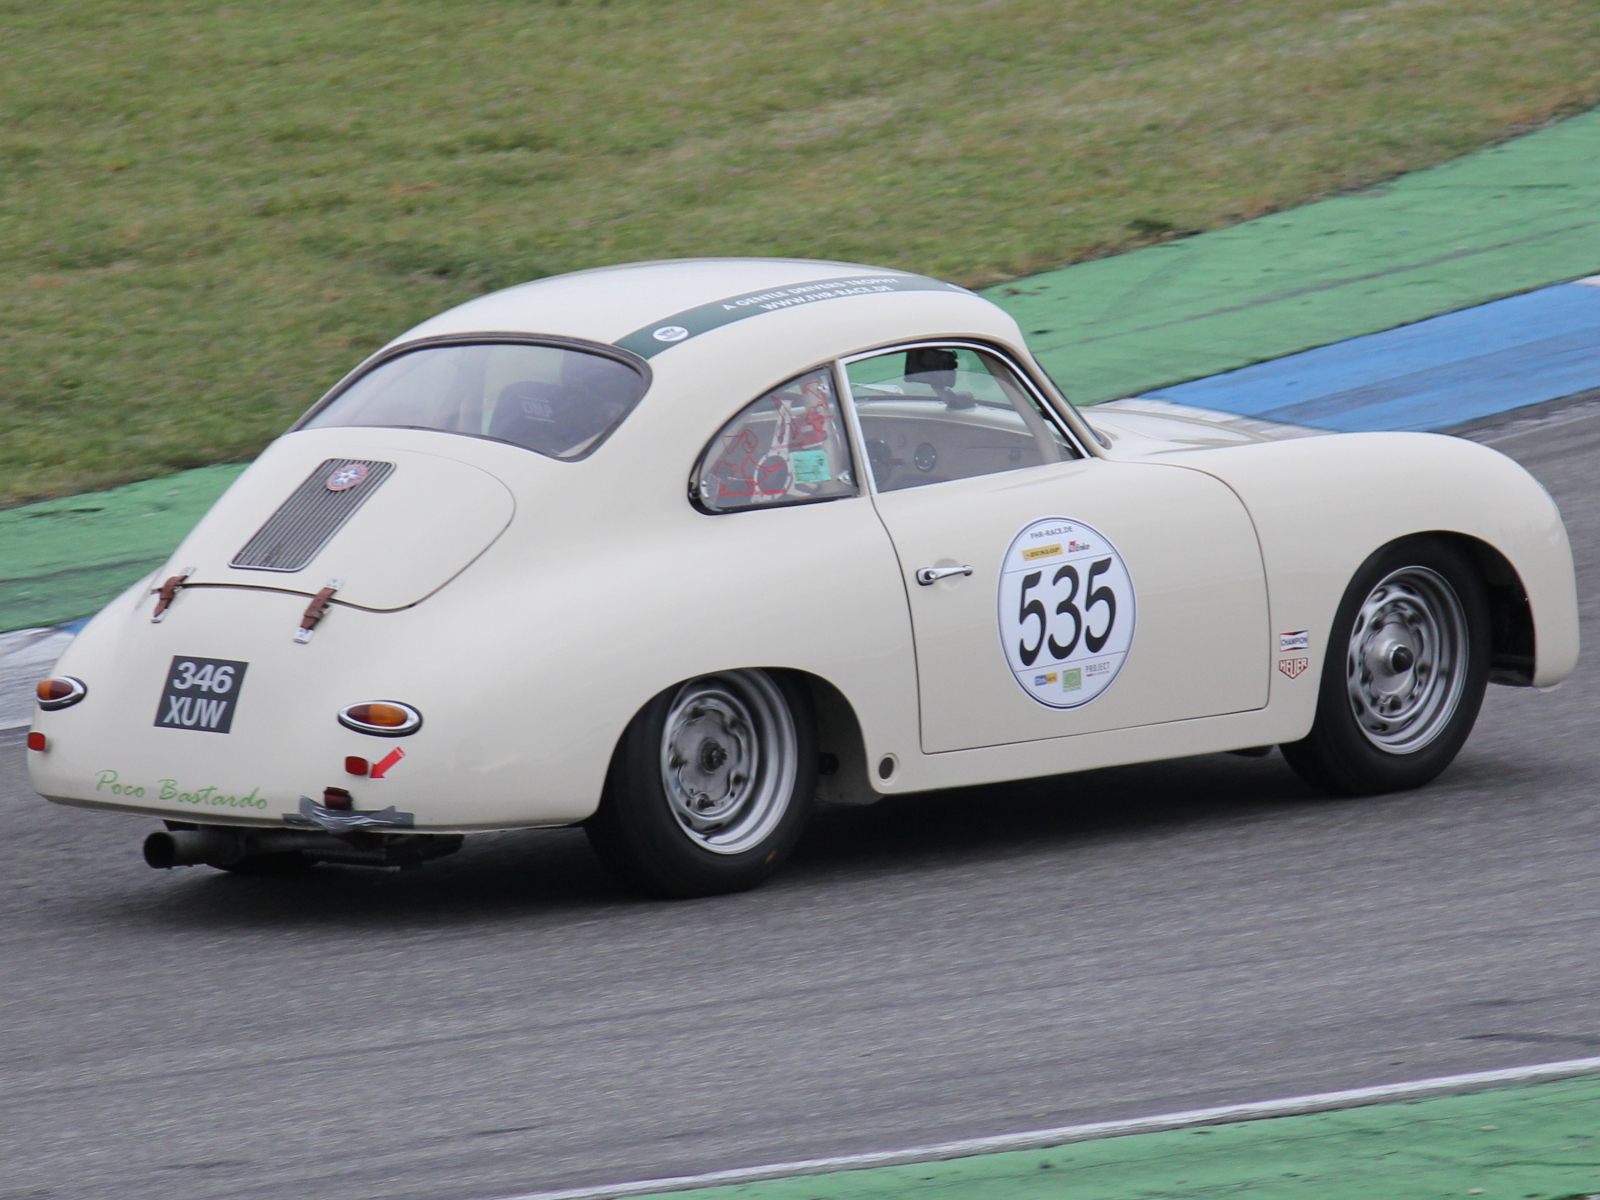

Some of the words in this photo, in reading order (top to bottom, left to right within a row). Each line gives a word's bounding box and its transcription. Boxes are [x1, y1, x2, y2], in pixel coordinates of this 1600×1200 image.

[722, 303, 737, 311] A
[735, 290, 790, 306] GENTLE
[787, 281, 847, 295] DRIVERS
[1030, 526, 1073, 539] FHR-RACE.DE
[1019, 557, 1116, 666] 535
[173, 662, 235, 693] 346
[1086, 661, 1110, 673] PROJECT
[163, 695, 227, 728] XUW
[95, 769, 145, 797] Poco
[158, 779, 267, 809] Bastardo
